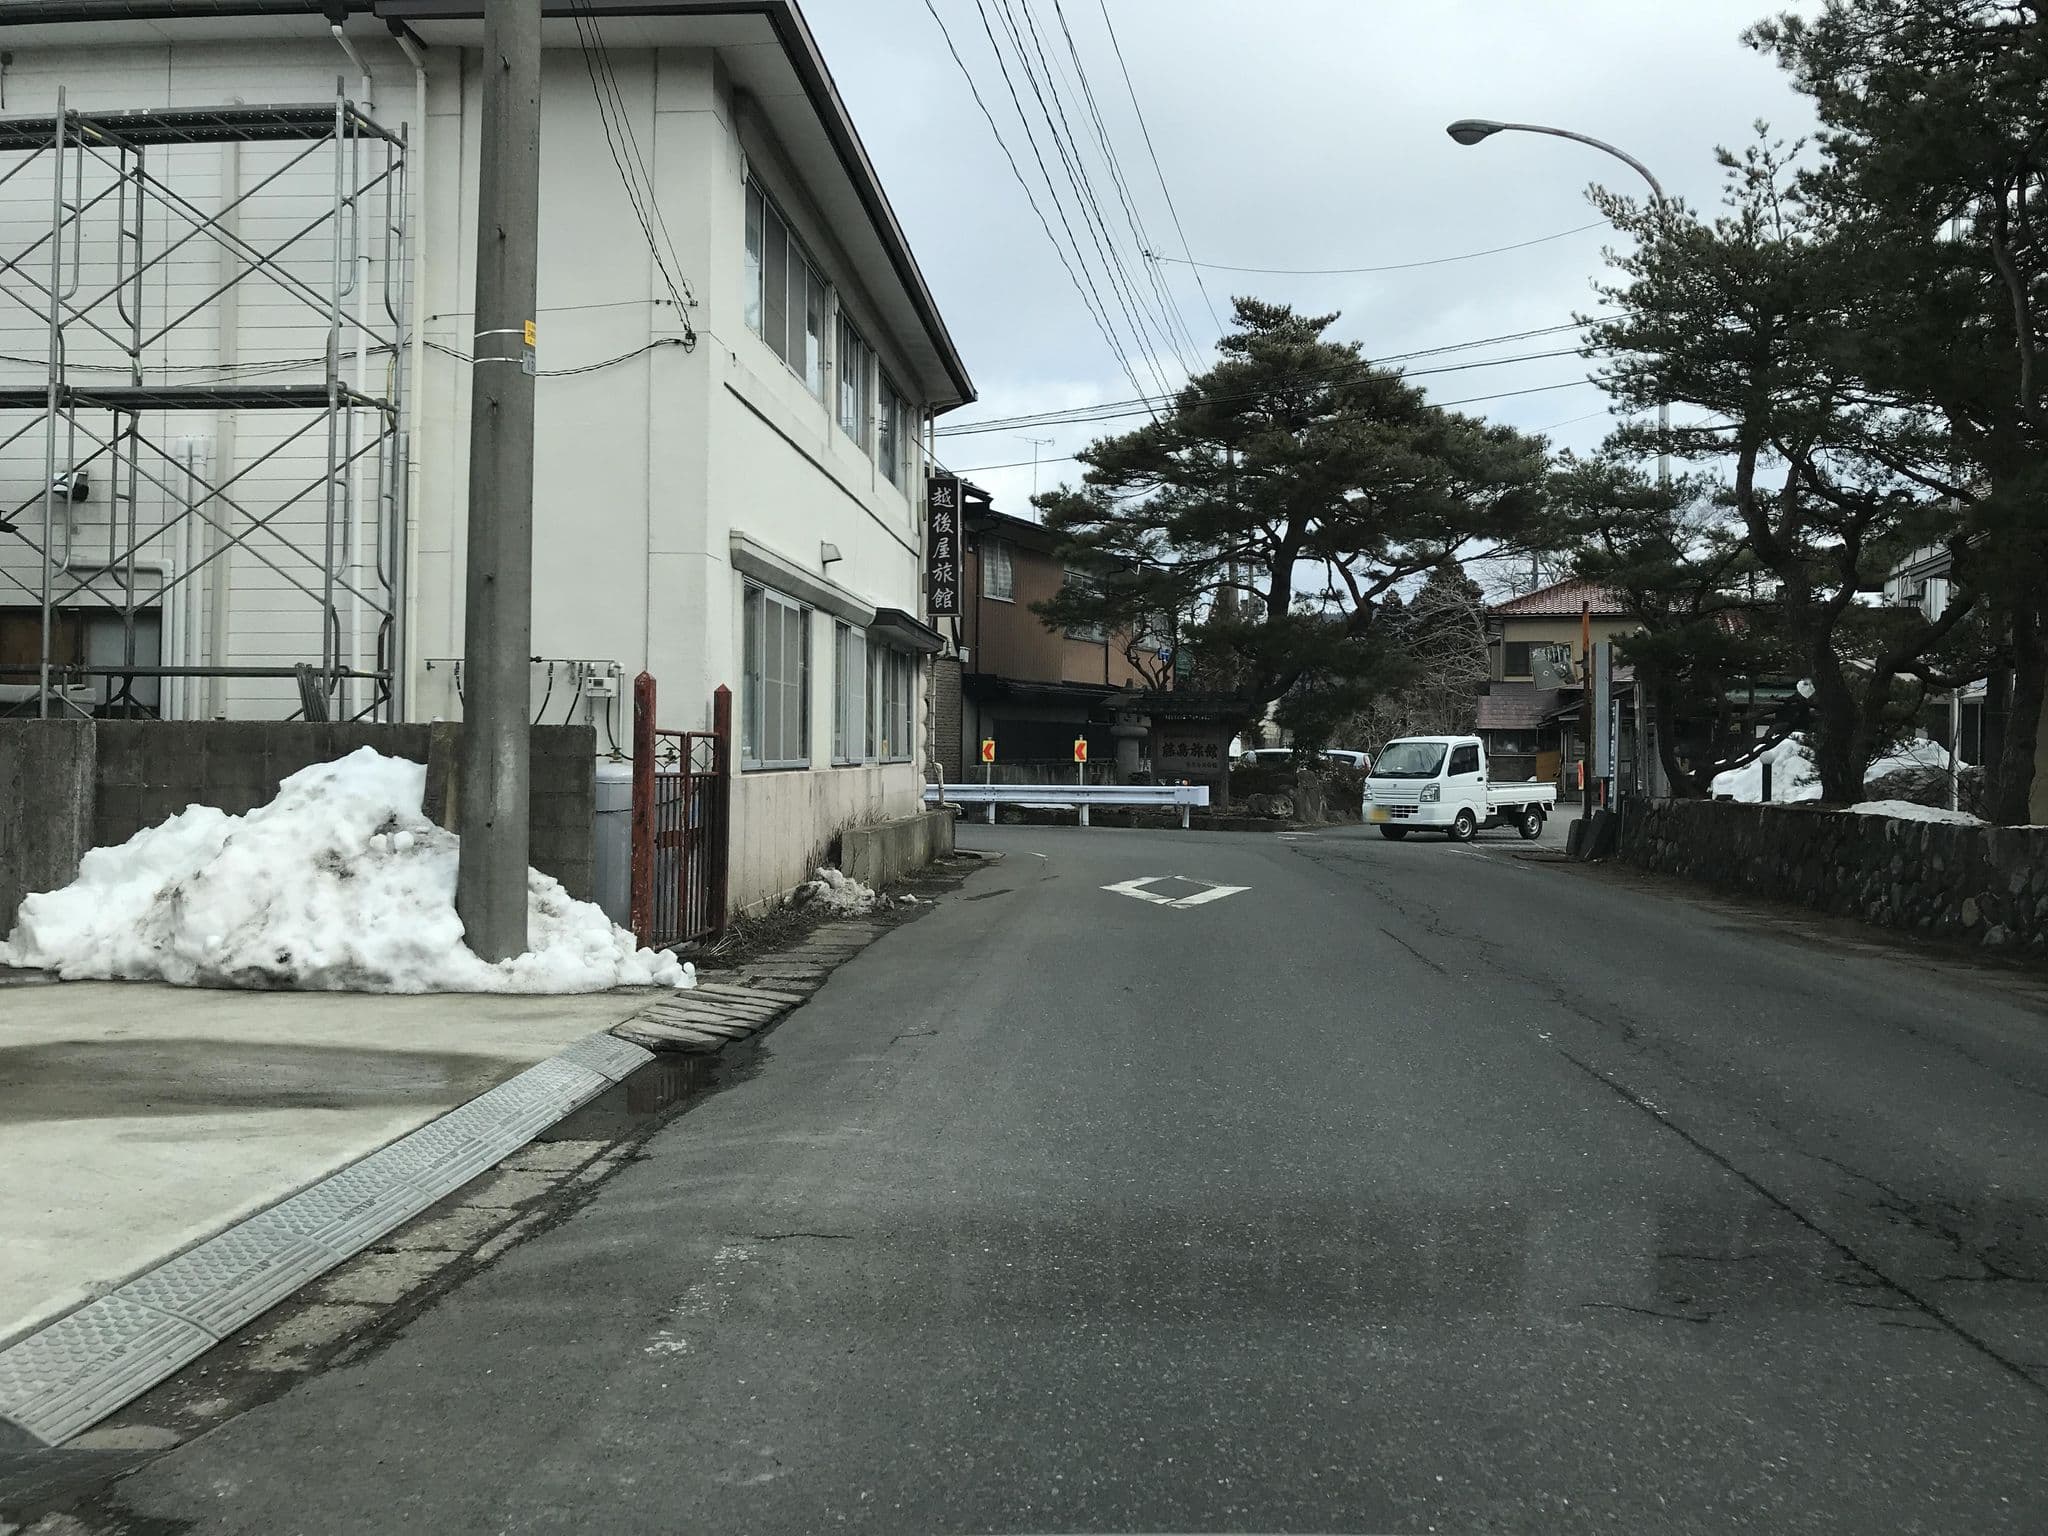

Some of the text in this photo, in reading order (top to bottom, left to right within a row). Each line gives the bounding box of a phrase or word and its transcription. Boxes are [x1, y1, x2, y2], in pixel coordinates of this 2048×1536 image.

[931, 486, 955, 609] 越後屋旅館
